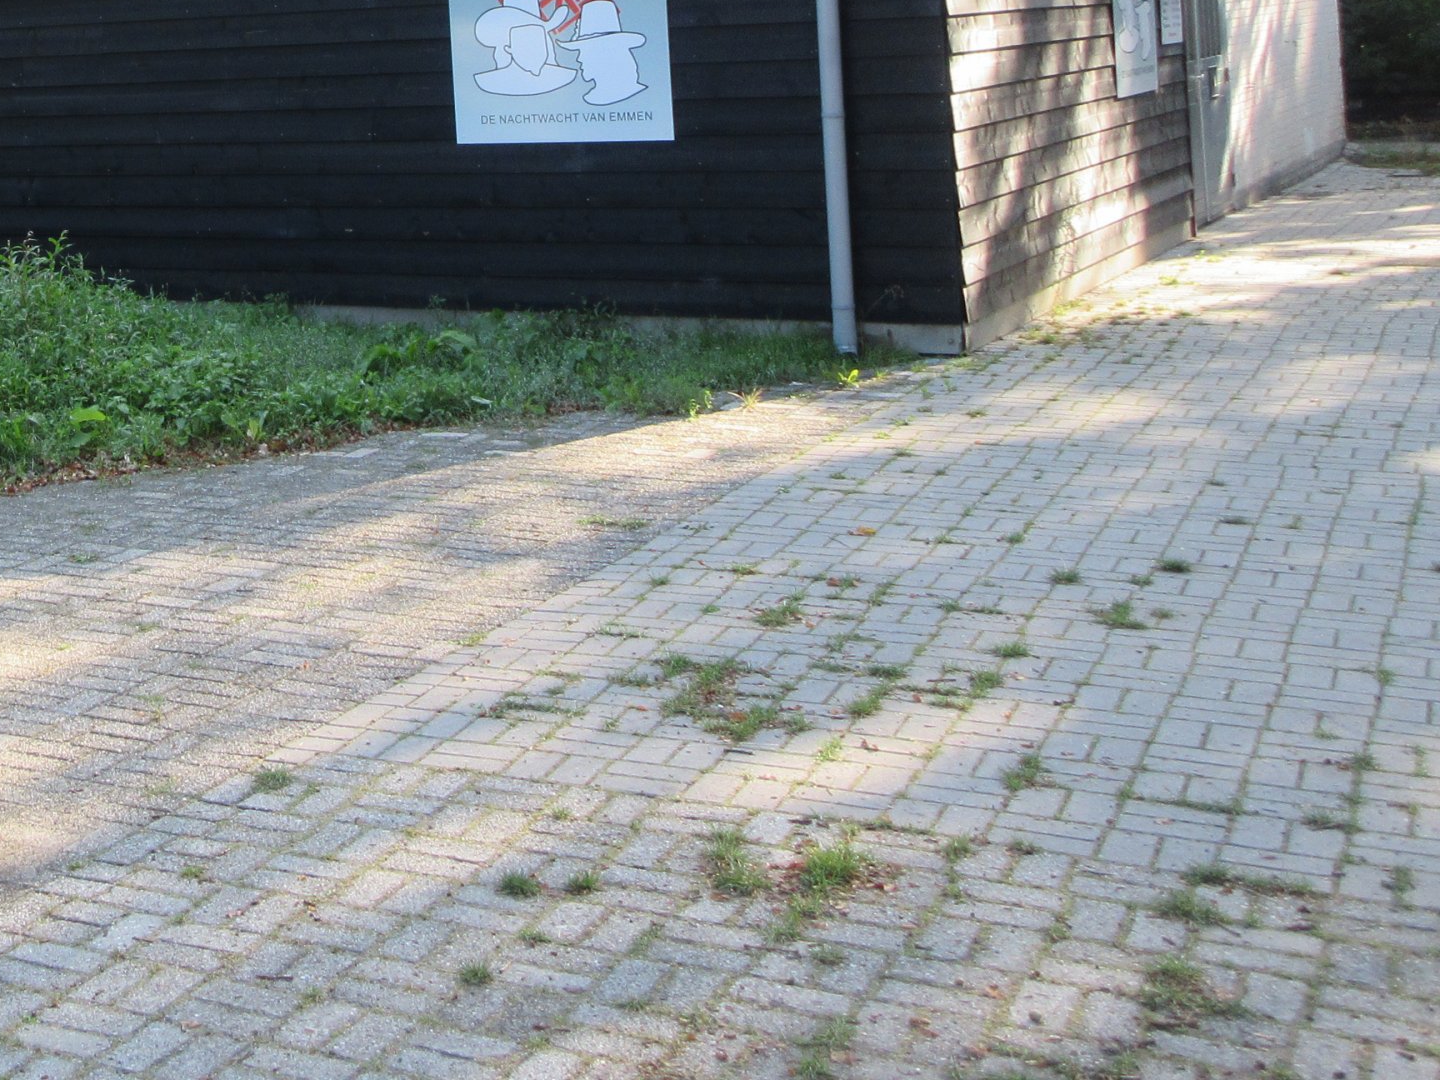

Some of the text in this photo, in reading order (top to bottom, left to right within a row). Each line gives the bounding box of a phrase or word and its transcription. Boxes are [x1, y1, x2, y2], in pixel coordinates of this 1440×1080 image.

[480, 111, 653, 125] DE NACHTWACHT VAN EMMEN
